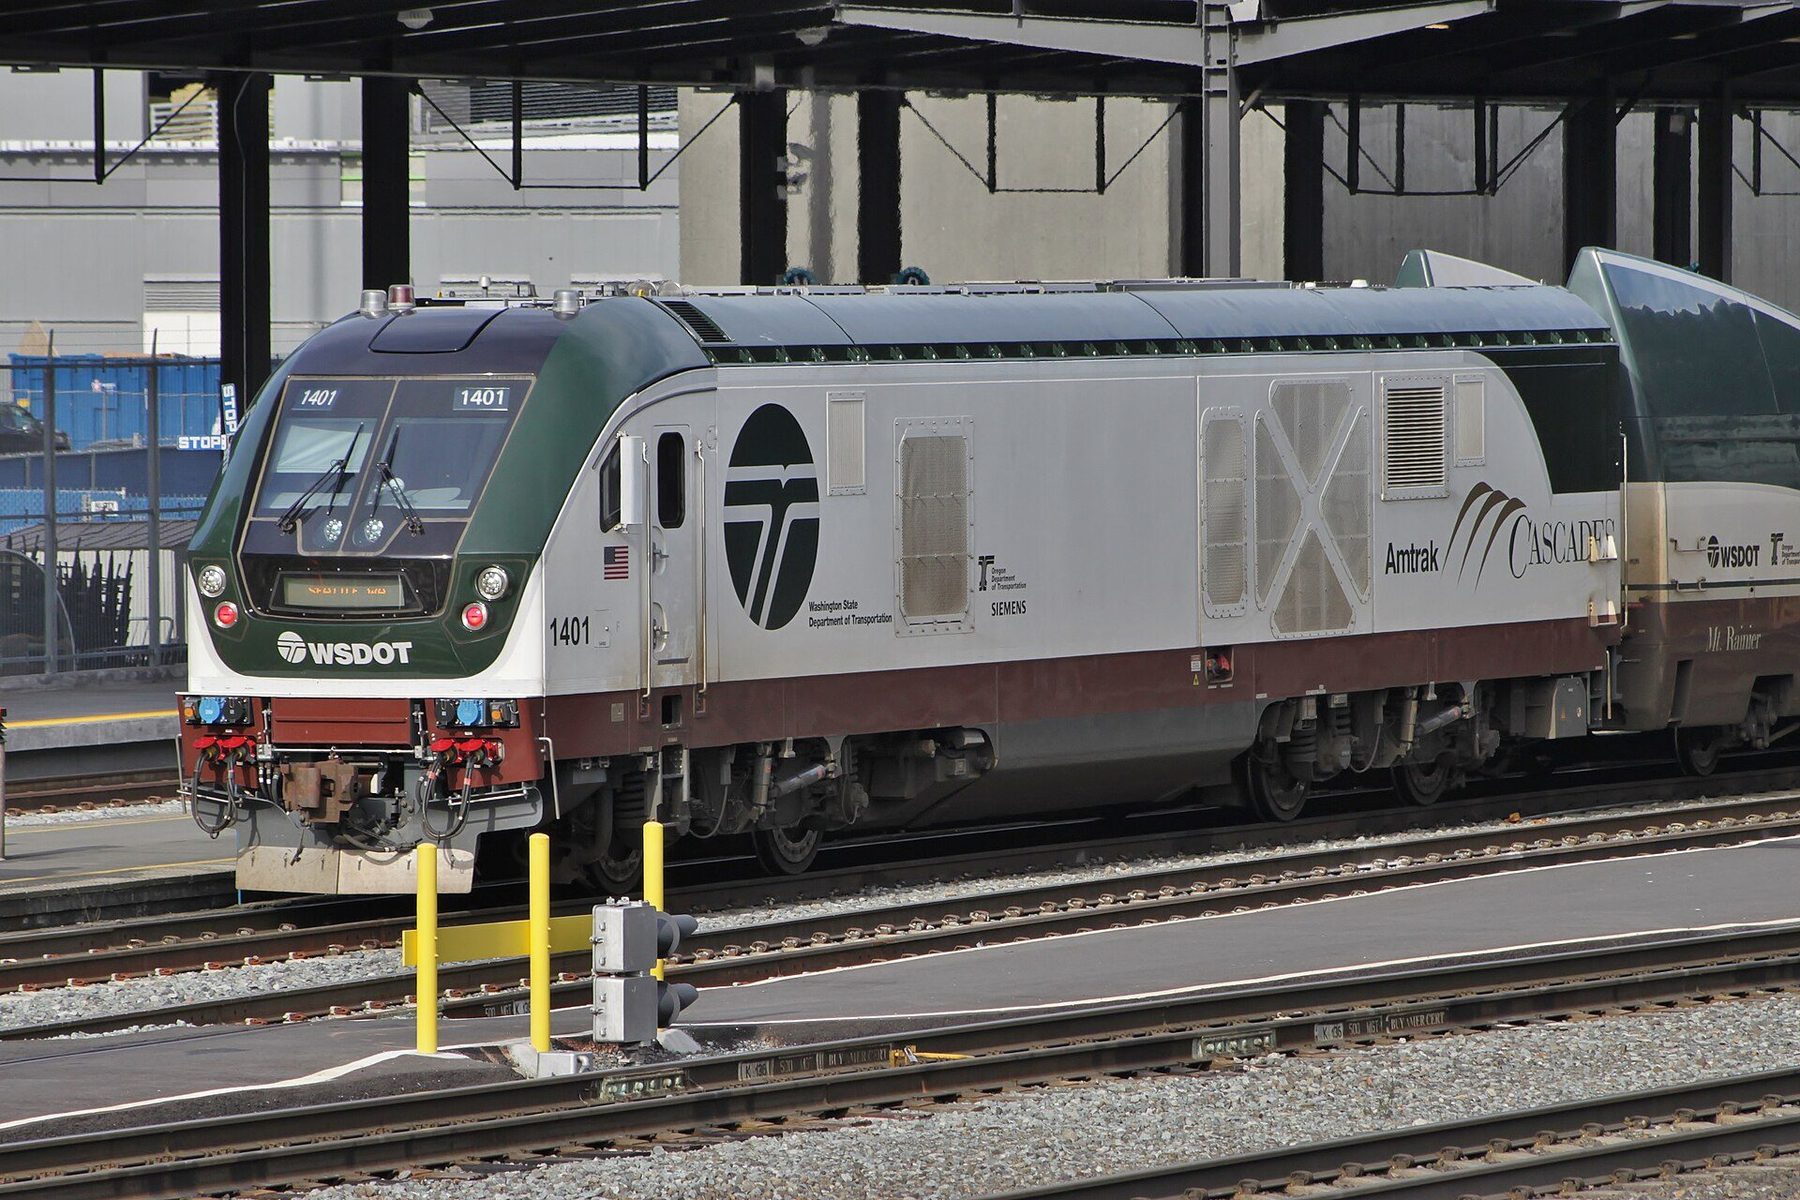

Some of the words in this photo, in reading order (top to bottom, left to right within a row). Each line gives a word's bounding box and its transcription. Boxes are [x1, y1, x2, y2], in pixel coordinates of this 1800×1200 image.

[301, 389, 337, 406] 1401
[461, 389, 504, 406] 1401
[223, 384, 237, 432] STOP
[178, 436, 221, 449] STOP
[1385, 540, 1439, 575] Amtrak
[1720, 545, 1760, 567] WSDOT
[991, 567, 1006, 575] Oregon
[991, 575, 1015, 583] Department
[997, 582, 1027, 591] Transportation
[808, 600, 842, 613] Washington
[843, 599, 858, 610] State
[991, 600, 1027, 617] SIEMENS
[808, 614, 843, 628] Department
[844, 614, 850, 625] of
[852, 612, 892, 626] Transportation
[550, 615, 589, 646] 1401
[1705, 626, 1722, 652] Mt.
[1726, 624, 1762, 651] Rainier
[307, 641, 413, 665] WSDOT
